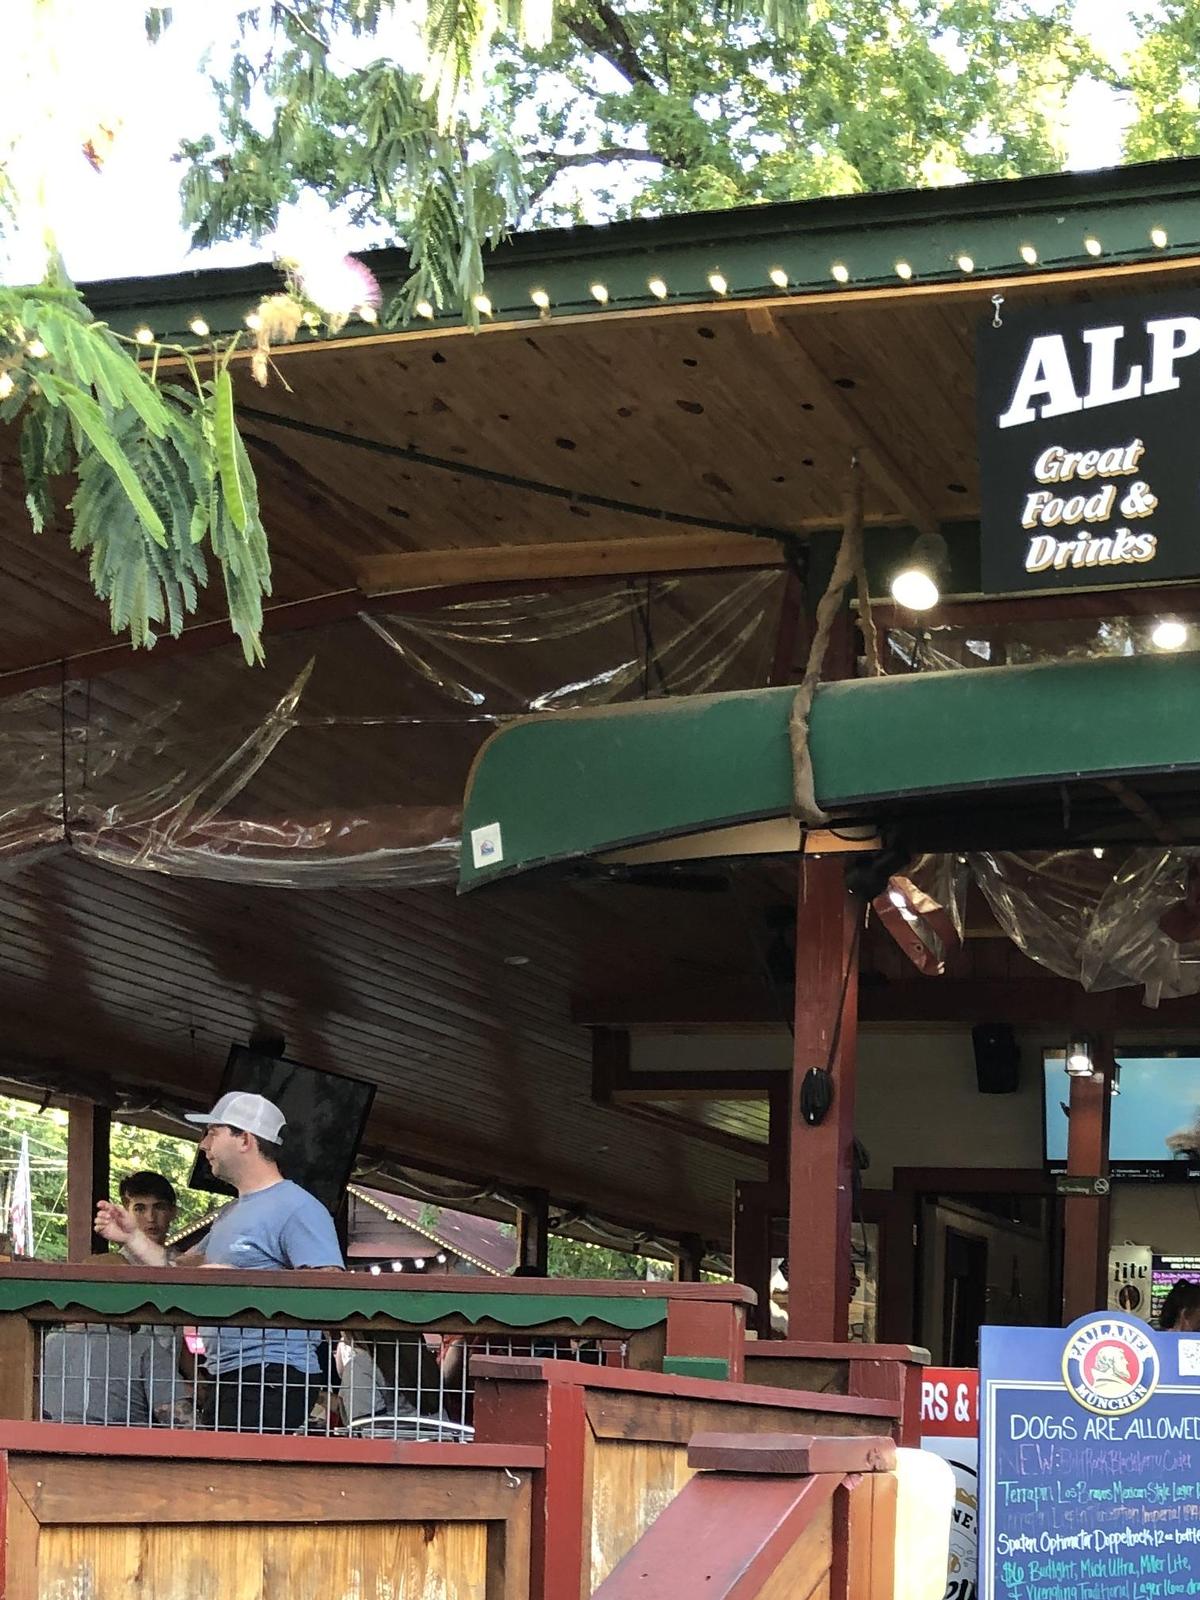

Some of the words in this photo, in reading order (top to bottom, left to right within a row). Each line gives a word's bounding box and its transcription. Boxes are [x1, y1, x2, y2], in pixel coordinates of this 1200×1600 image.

[1033, 437, 1145, 487] Great
[1021, 482, 1111, 530] Food
[1117, 480, 1159, 518] &
[1023, 527, 1158, 575] Drinks
[1068, 1324, 1153, 1362] PAULANER
[954, 1382, 971, 1422] &
[1010, 1414, 1078, 1441] DOGS
[1083, 1416, 1123, 1441] ARE
[997, 1480, 1054, 1512] Terrapin
[1056, 1480, 1077, 1504] Los
[996, 1531, 1040, 1557] Spaten
[1040, 1530, 1094, 1556] Optimator
